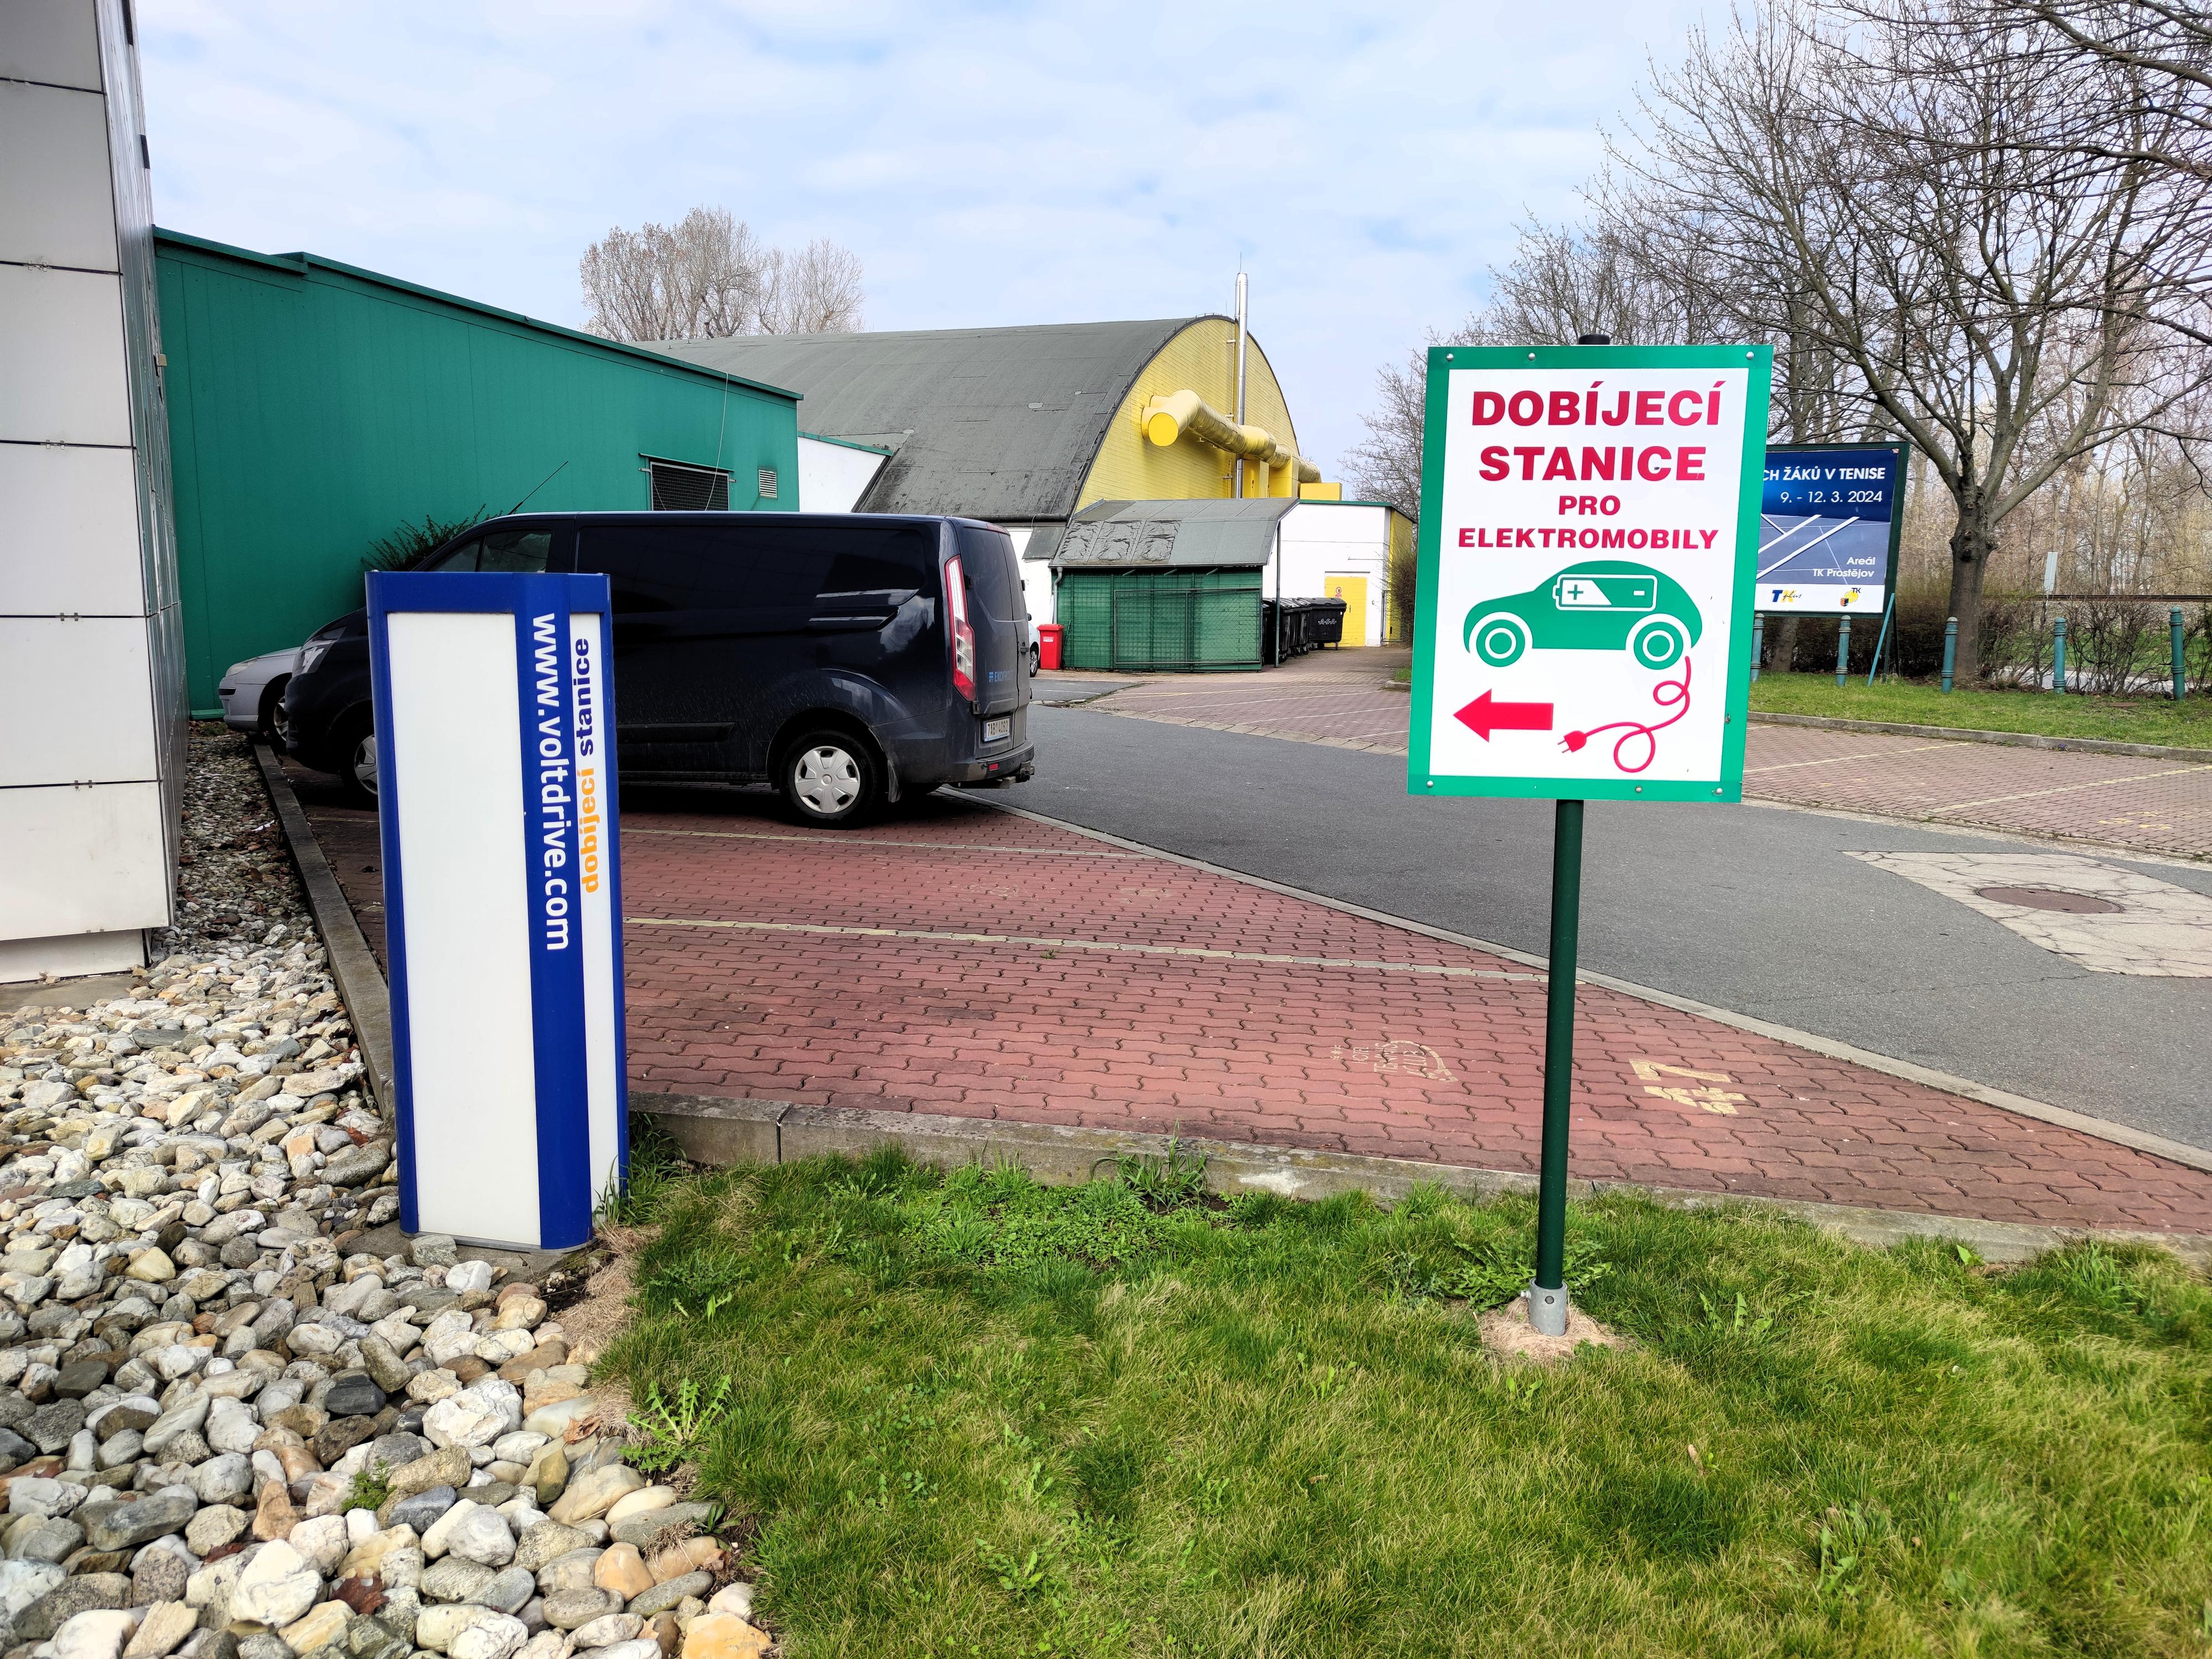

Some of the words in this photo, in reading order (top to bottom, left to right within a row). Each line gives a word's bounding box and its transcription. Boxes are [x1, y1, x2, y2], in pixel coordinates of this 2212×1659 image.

[1472, 380, 1726, 426] DOBÍJECÍ
[1479, 446, 1707, 481] STANICE
[1783, 466, 1820, 481] ŽÁKŮ
[1825, 468, 1836, 479] V
[1839, 468, 1886, 479] TENISE
[1558, 495, 1621, 515] PRO
[1780, 492, 1792, 503] 9.
[1808, 491, 1826, 503] 12.
[1831, 491, 1843, 503] 3.
[1848, 491, 1882, 502] 2024
[1458, 528, 1719, 549] ELEKTROMOBILY
[1846, 556, 1876, 565] Areál
[1813, 568, 1824, 577] TK
[1827, 568, 1875, 578] Prostějov
[572, 638, 594, 757] stanice
[533, 612, 571, 951] www.voltdrive.com
[576, 768, 600, 893] dobíjecí
